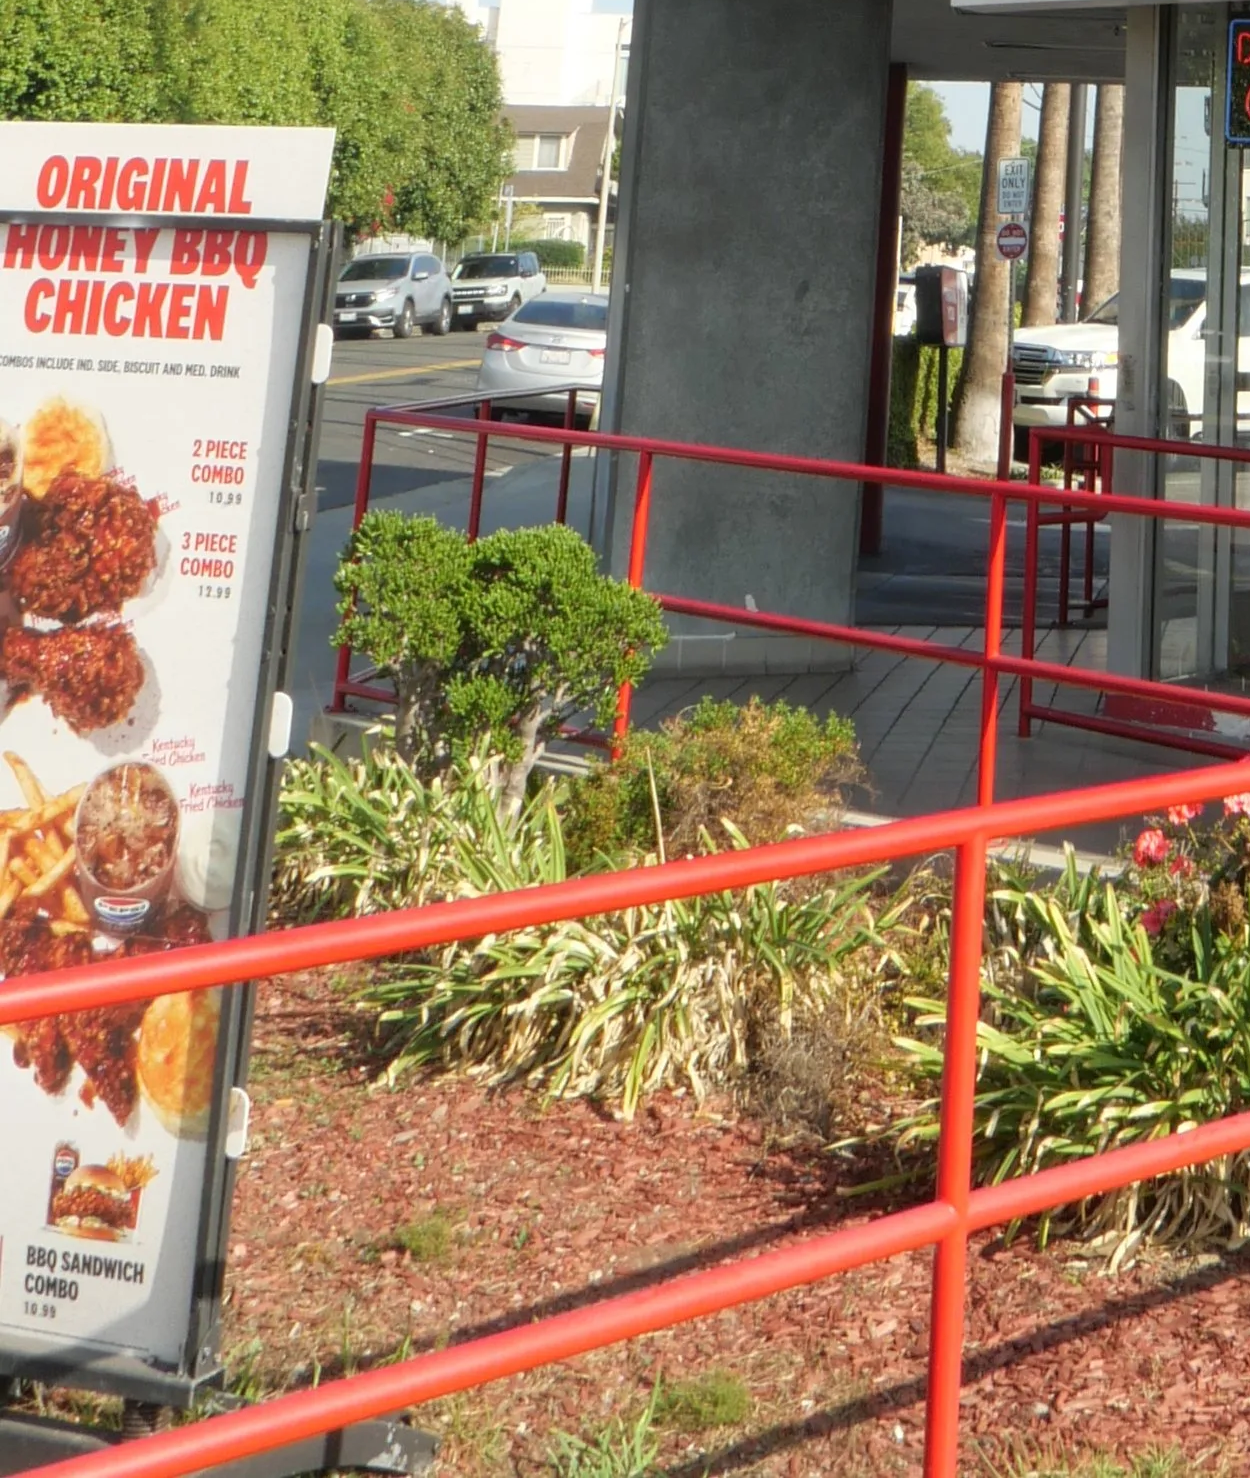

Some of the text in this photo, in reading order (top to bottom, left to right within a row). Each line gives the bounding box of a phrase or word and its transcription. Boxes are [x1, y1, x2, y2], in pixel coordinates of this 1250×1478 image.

[1004, 164, 1024, 176] EXIT
[36, 155, 253, 214] ORIGINAL
[1001, 177, 1026, 189] ONLY
[1002, 190, 1025, 199] DO NOT
[1003, 200, 1023, 208] ENTER
[2, 224, 269, 290] HONEY BBQ
[24, 277, 230, 342] CHICKEN
[36, 356, 75, 371] INCLUDE
[77, 358, 95, 372] IND.
[123, 360, 161, 375] BISCUIT
[162, 362, 183, 376] AND
[185, 363, 208, 378] MED.
[210, 365, 241, 379] DRINK
[192, 439, 248, 460] 2 PIECE
[191, 464, 245, 486] COMBO
[209, 491, 243, 505] 10.99
[181, 531, 238, 554] 3 PIECE
[180, 556, 234, 579] COMBO
[198, 584, 232, 599] 12.99
[152, 736, 196, 753] Kentucky
[168, 750, 206, 767] Chicken
[189, 780, 234, 799] Kentucky
[179, 798, 204, 814] Fried
[26, 1244, 145, 1284] BBQ SANDWICH
[24, 1273, 79, 1301] COMBO
[23, 1301, 57, 1319] 10.99
